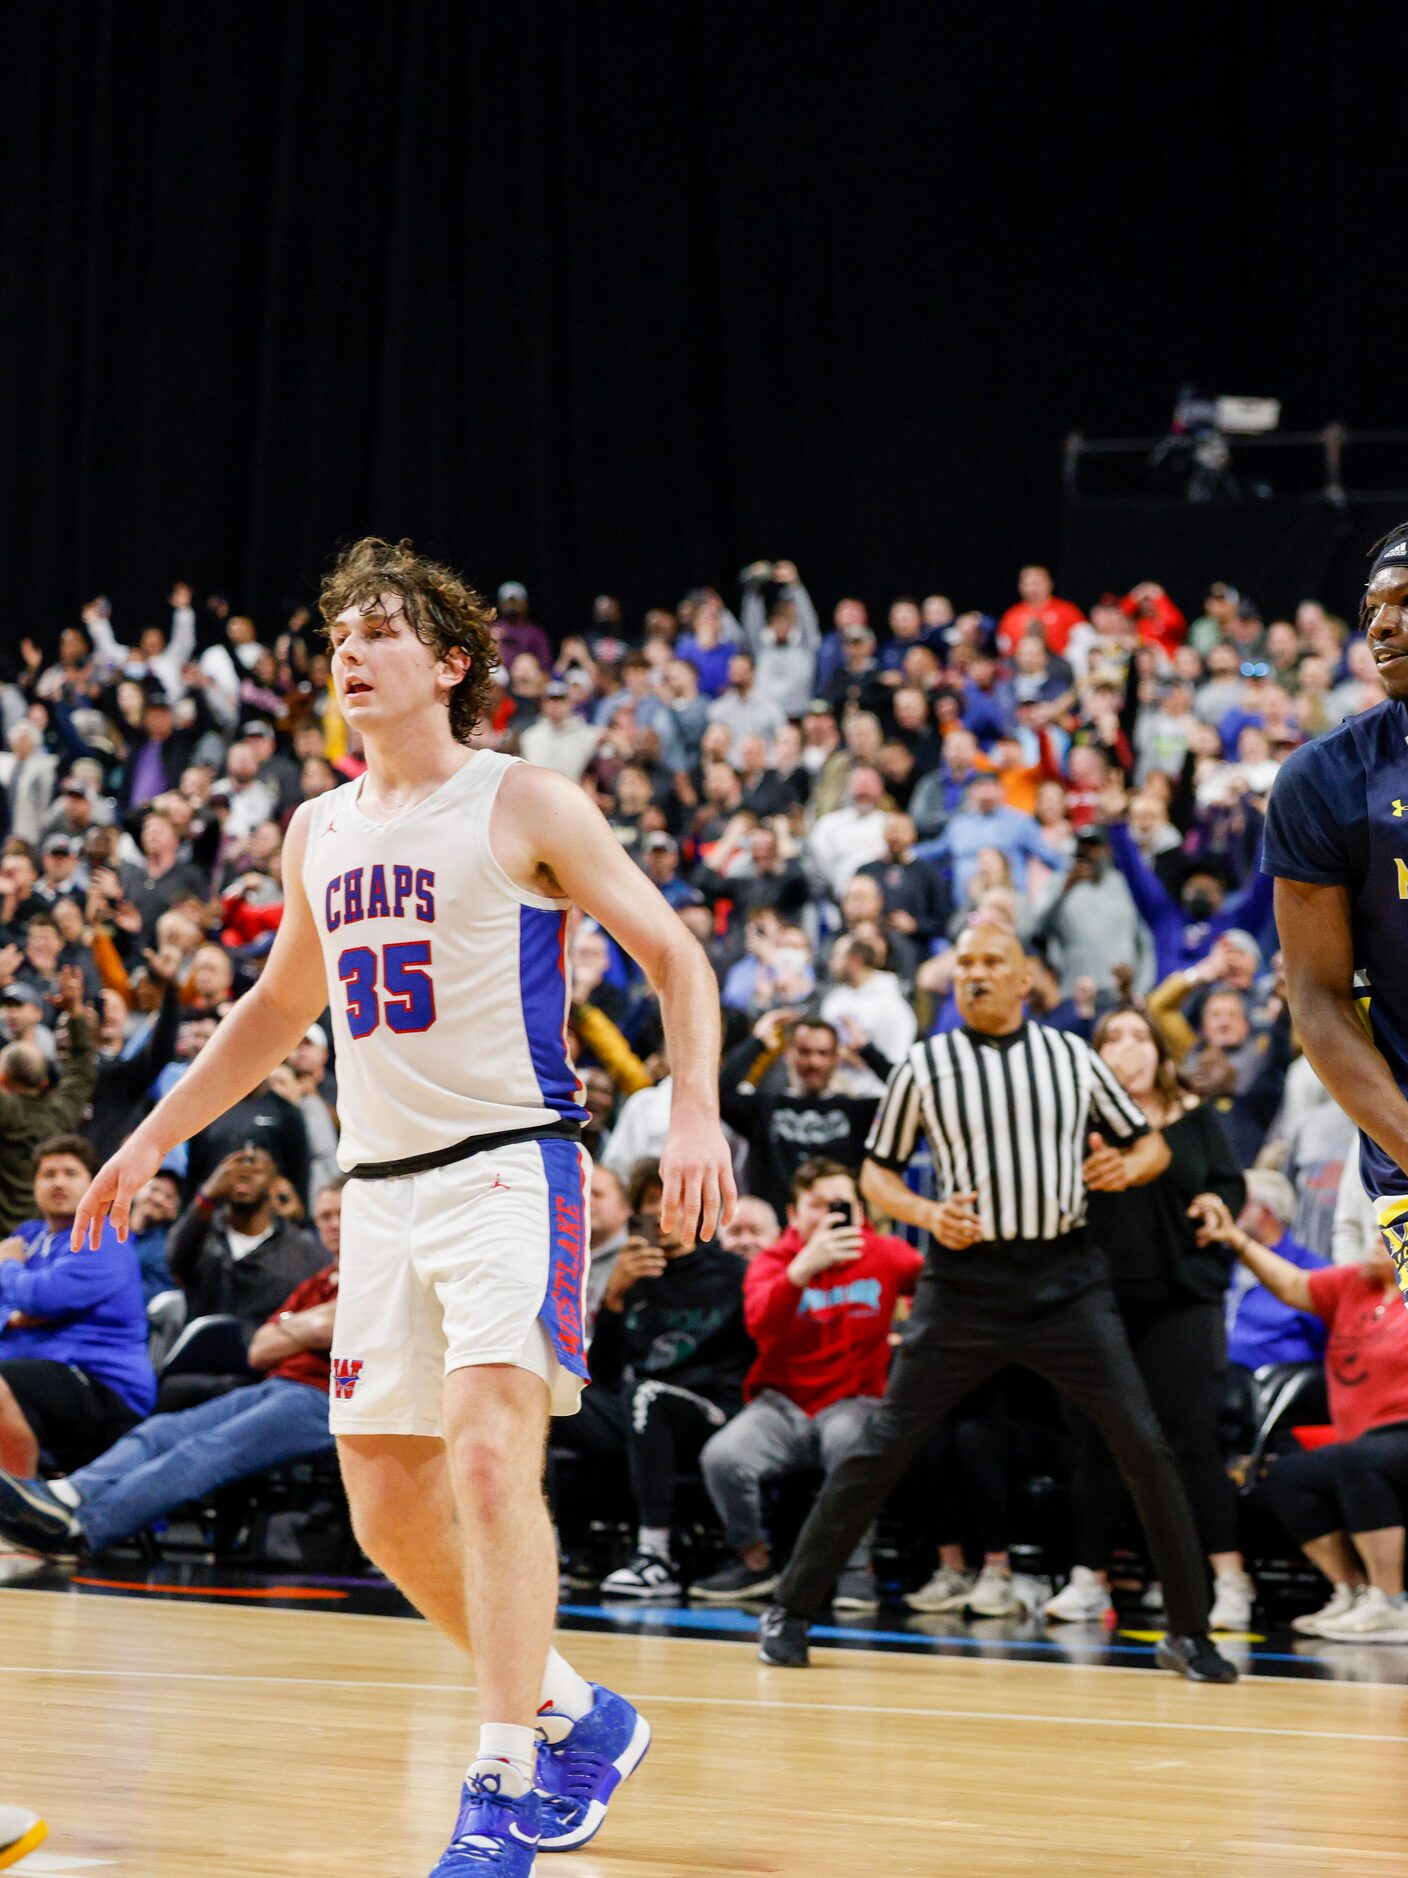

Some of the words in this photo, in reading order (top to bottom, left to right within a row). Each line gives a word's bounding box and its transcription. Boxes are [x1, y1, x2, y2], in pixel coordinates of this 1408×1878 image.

[326, 864, 435, 933] CHAPS
[338, 940, 436, 1040] 35
[552, 1196, 581, 1355] WESTLAKE
